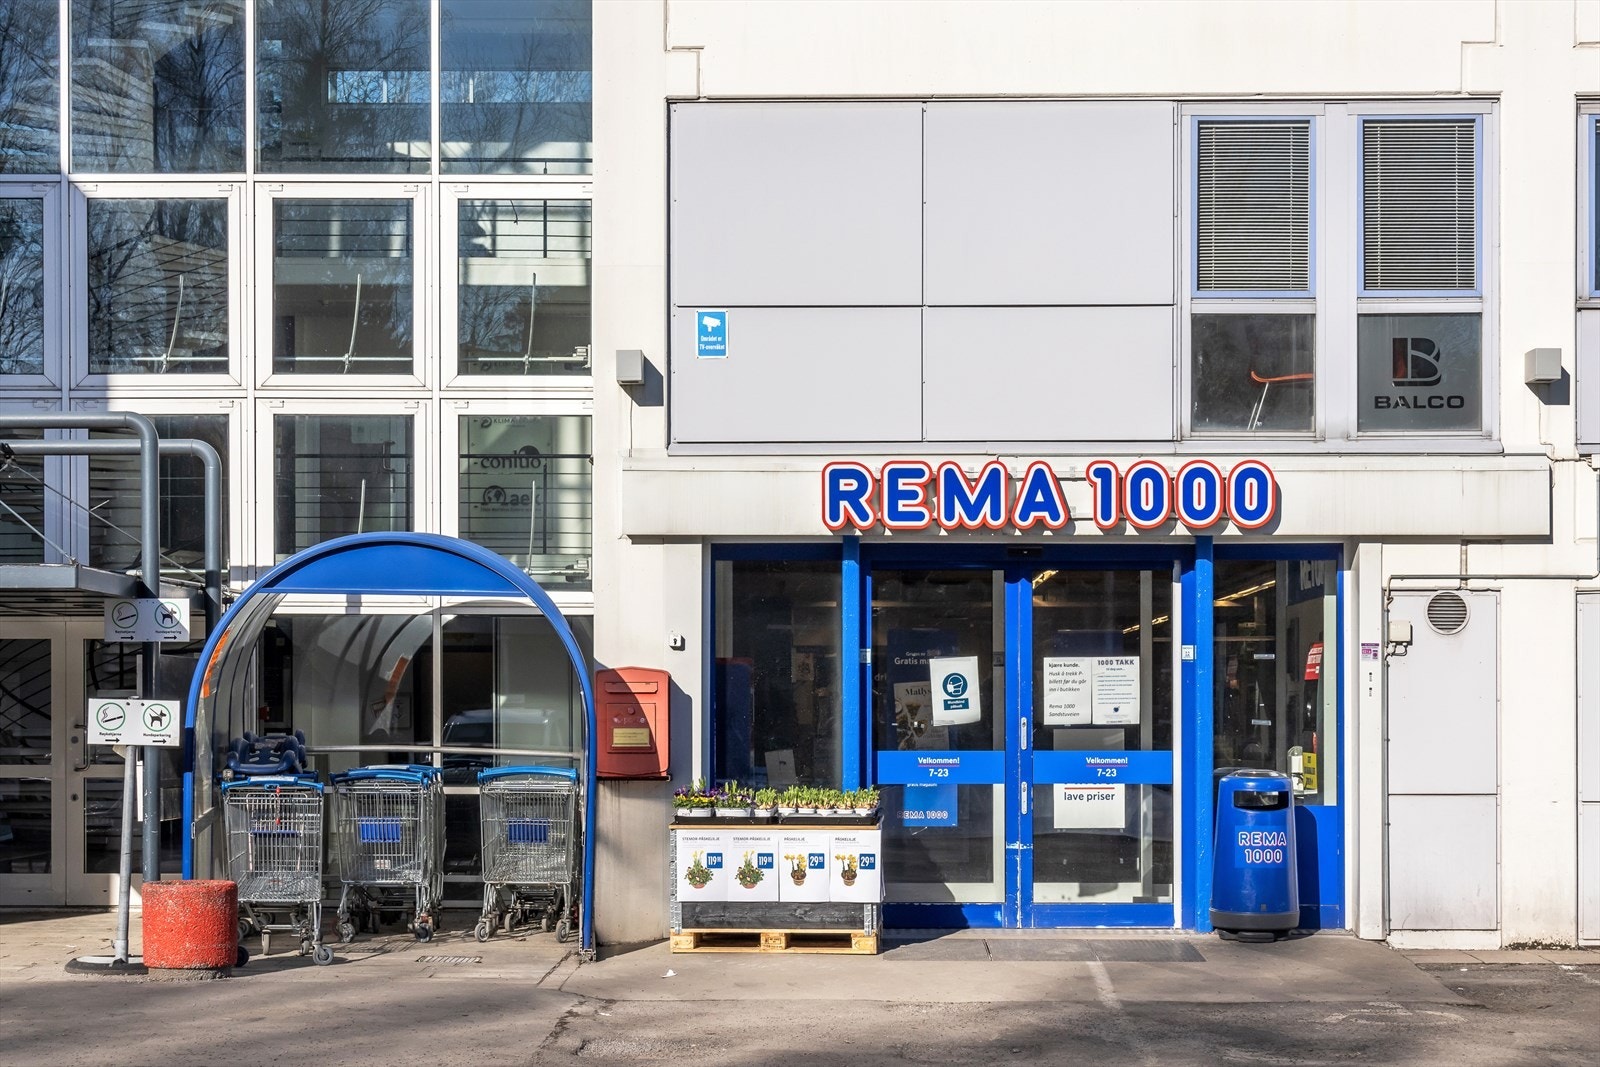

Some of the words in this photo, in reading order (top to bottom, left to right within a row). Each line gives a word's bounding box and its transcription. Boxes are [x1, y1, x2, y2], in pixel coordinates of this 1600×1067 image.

[1374, 396, 1465, 409] BALCO
[822, 461, 1068, 530] REMA
[1086, 460, 1275, 530] 1000
[894, 657, 918, 665] Gratis
[929, 768, 949, 777] 7-23
[1097, 768, 1117, 777] 7-23
[1064, 792, 1084, 801] lave
[1086, 791, 1116, 802] priser
[926, 810, 948, 819] 1000
[1238, 831, 1287, 847] REMA
[1244, 848, 1283, 864] 1000
